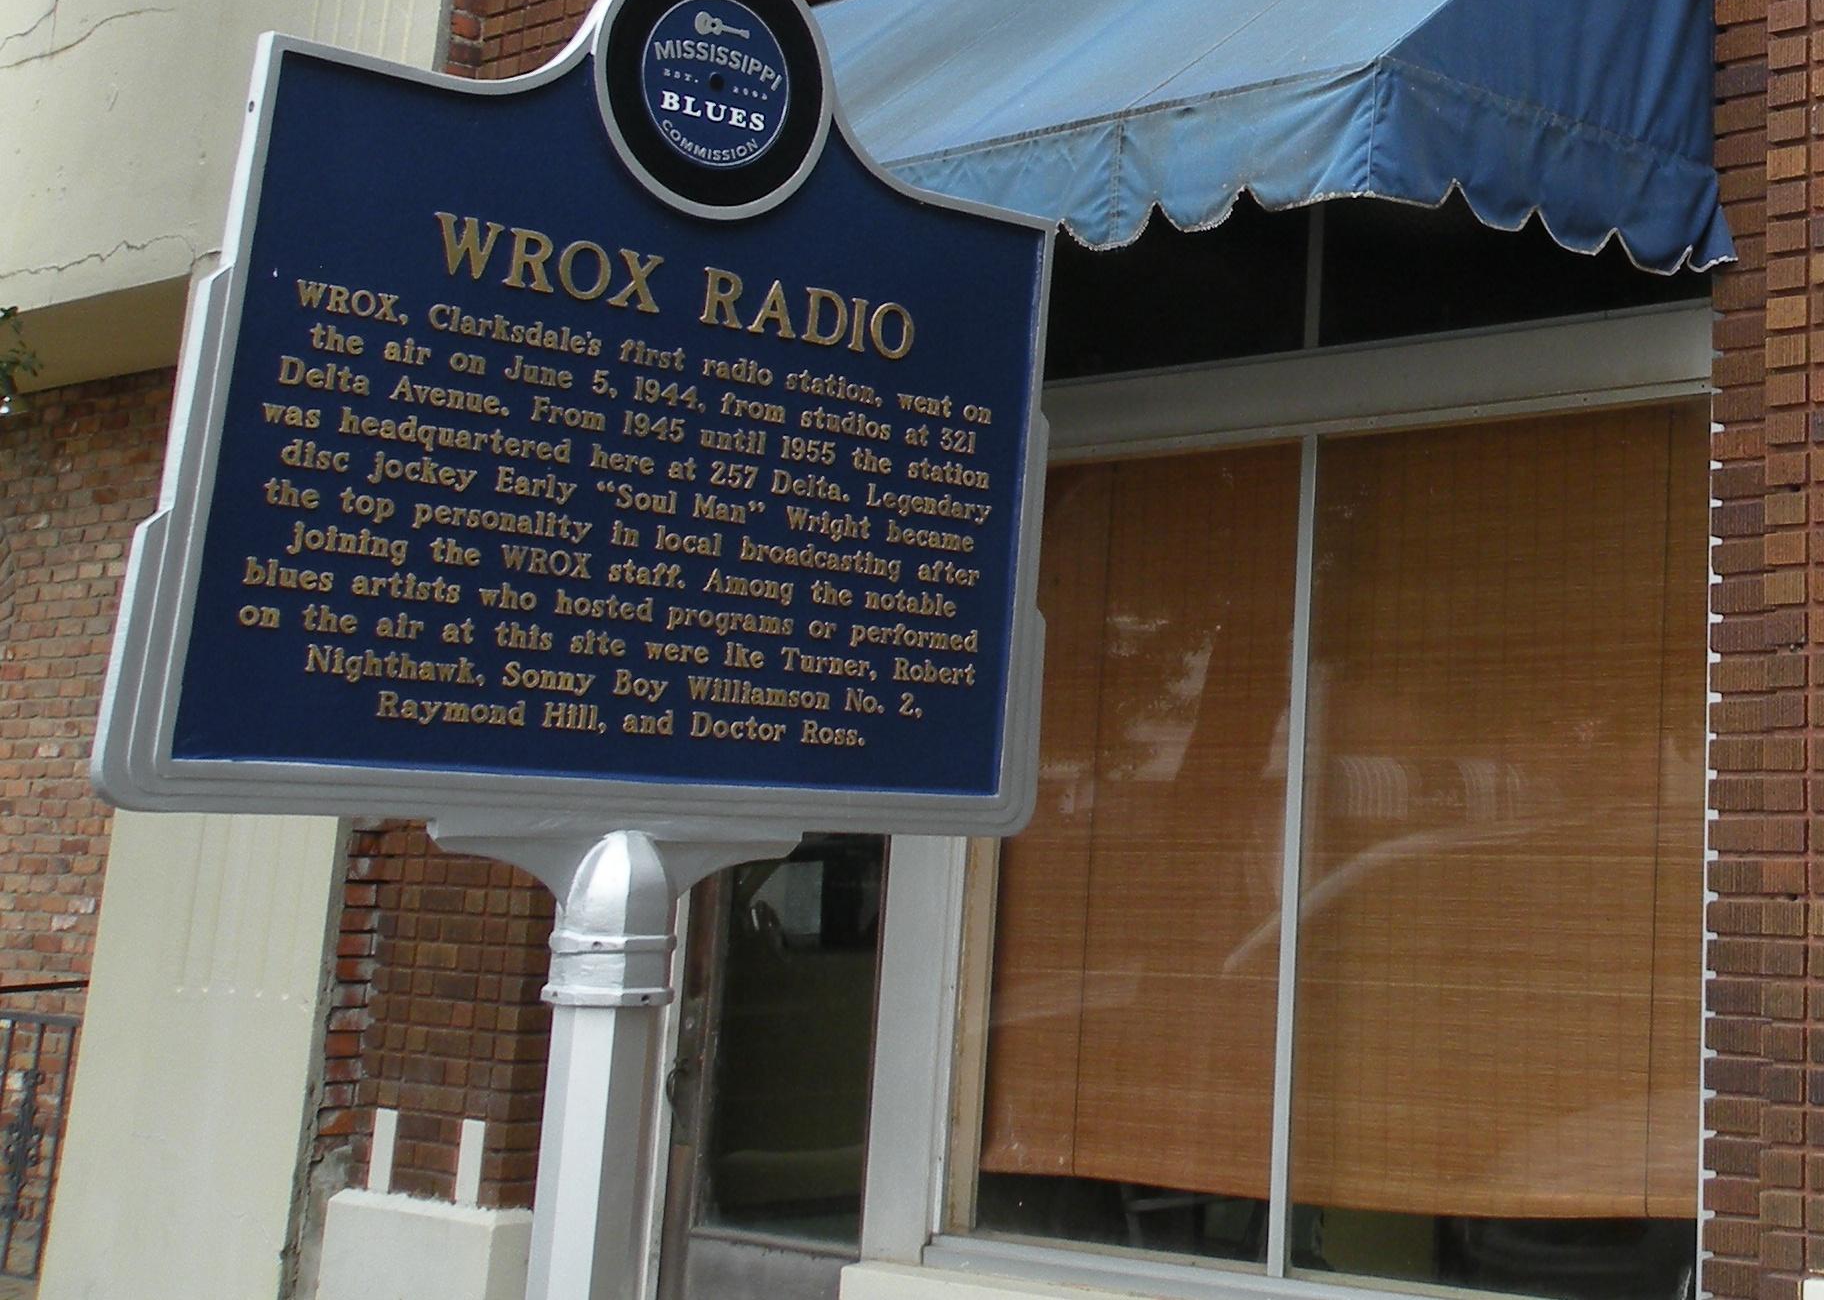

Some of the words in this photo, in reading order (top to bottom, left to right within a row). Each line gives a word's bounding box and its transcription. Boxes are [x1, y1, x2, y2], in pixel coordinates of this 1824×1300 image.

[654, 39, 783, 92] MISSISSIPPI
[660, 90, 766, 132] BLUES
[662, 119, 759, 160] COMMISSION
[434, 211, 665, 314] WROX
[699, 266, 916, 360] RADIO
[297, 278, 409, 326] WROX,
[428, 303, 603, 358] Clarksdale's
[618, 338, 686, 371] first
[702, 357, 774, 387] radio
[785, 369, 884, 408] station,
[897, 392, 953, 418] went
[963, 402, 992, 425] on
[309, 322, 365, 356] the
[383, 337, 432, 367] air
[449, 351, 488, 376] on
[504, 355, 574, 390] June
[591, 368, 619, 399] 5,
[719, 392, 787, 424] from
[800, 405, 893, 441] studios
[904, 424, 930, 448] at
[939, 427, 977, 455] 321
[261, 402, 322, 429] was
[338, 406, 572, 464] headquartered
[590, 442, 655, 475] here
[667, 457, 697, 483] at
[710, 460, 760, 490] 257
[770, 468, 851, 503] Delta.
[865, 482, 992, 525] Legendary
[278, 355, 371, 397] Delta
[388, 374, 511, 418] Avenue.
[530, 395, 608, 432] From
[623, 410, 687, 443] 1945
[700, 427, 767, 457] until
[780, 435, 837, 466] 1955
[851, 447, 893, 476] the
[907, 458, 990, 490] station
[264, 477, 321, 510] the
[339, 486, 396, 524] top
[411, 502, 594, 544] personality
[610, 520, 641, 548] in
[654, 524, 723, 558] local
[740, 535, 902, 581] broadcasting
[917, 560, 981, 587] after
[280, 439, 351, 474] disc
[366, 451, 478, 493] jockey
[494, 465, 578, 506] Early
[786, 504, 872, 543] Wright
[885, 519, 975, 553] became
[242, 556, 336, 592] blues
[351, 572, 462, 604] artists
[479, 582, 538, 612] who
[554, 590, 654, 623] hosted
[666, 605, 795, 637] programs
[808, 619, 837, 640] or
[849, 628, 979, 654] performed
[286, 521, 409, 566] joining
[430, 537, 482, 568] the
[501, 544, 592, 581] WROX
[607, 559, 687, 589] staff.
[702, 567, 795, 606] Among
[810, 579, 854, 607] the
[864, 591, 958, 619] notable
[238, 604, 281, 630] on
[302, 603, 359, 635] the
[375, 612, 425, 640] air
[441, 618, 476, 645] at
[495, 621, 554, 651] this
[569, 629, 627, 658] site
[645, 640, 710, 665] were
[780, 646, 879, 682] Turner,
[891, 657, 976, 687] Robert
[304, 643, 486, 688] Nighthawk,
[501, 661, 596, 697] Sonny
[612, 669, 670, 703] Boy
[687, 674, 831, 711] Williamson
[845, 688, 885, 715] No.
[898, 692, 924, 720] 2,
[375, 690, 526, 728] Raymond
[541, 701, 608, 736] Hill,
[622, 710, 674, 737] and
[690, 711, 787, 743] Doctor
[800, 720, 866, 748] Ross.
